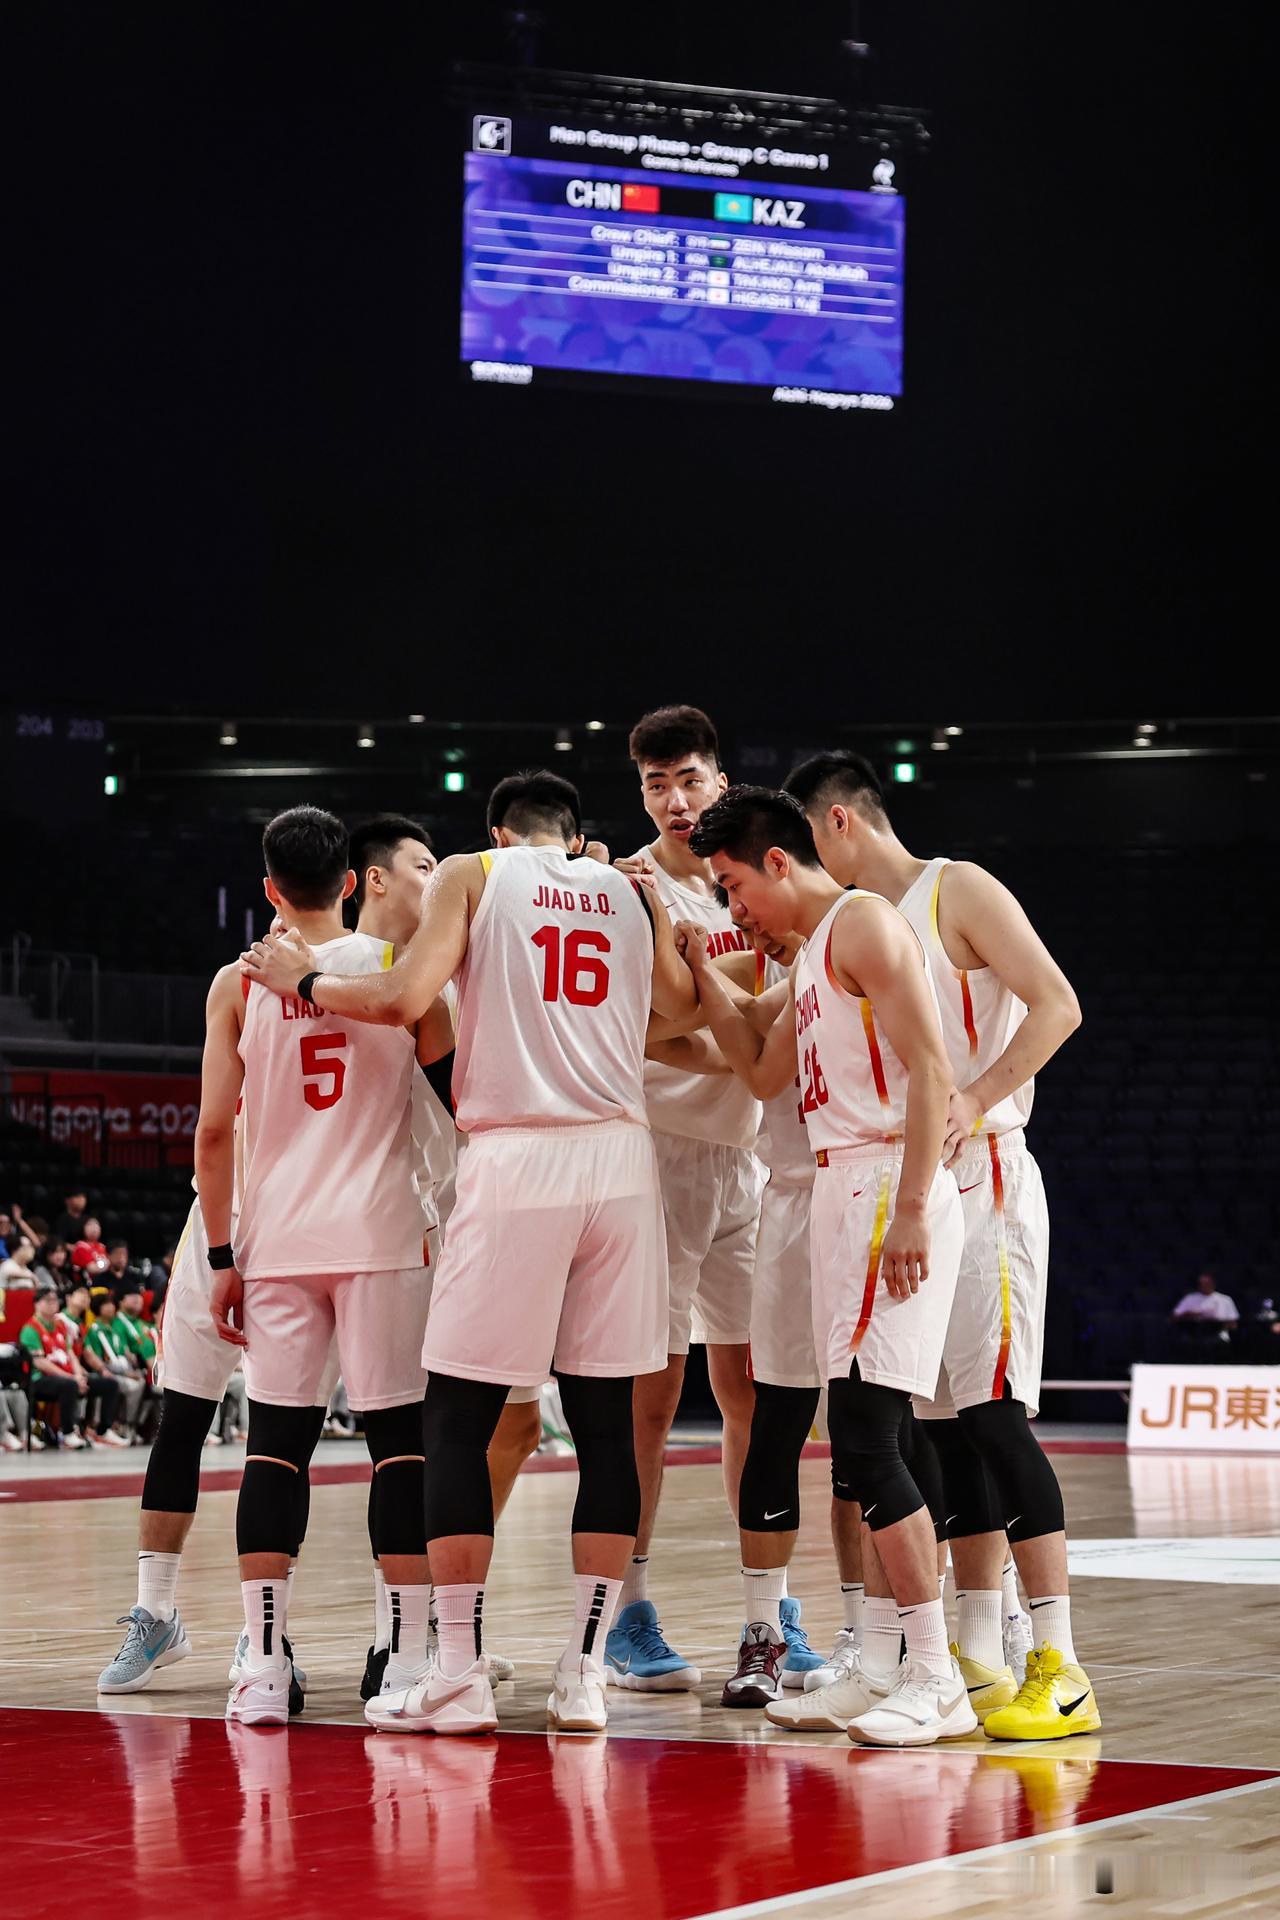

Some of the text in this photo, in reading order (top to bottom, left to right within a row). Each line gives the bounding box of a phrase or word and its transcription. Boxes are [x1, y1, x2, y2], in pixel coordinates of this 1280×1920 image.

[586, 130, 638, 154] Group
[701, 142, 753, 166] Group
[753, 147, 769, 164] C
[566, 180, 621, 211] CHN
[753, 198, 806, 229] KAZ
[533, 885, 616, 915] JIAO B.Q.
[706, 930, 753, 960] HIN
[531, 925, 611, 1007] 16
[795, 983, 820, 1036] CHINA
[300, 1032, 347, 1111] 5
[140, 1103, 201, 1136] 202
